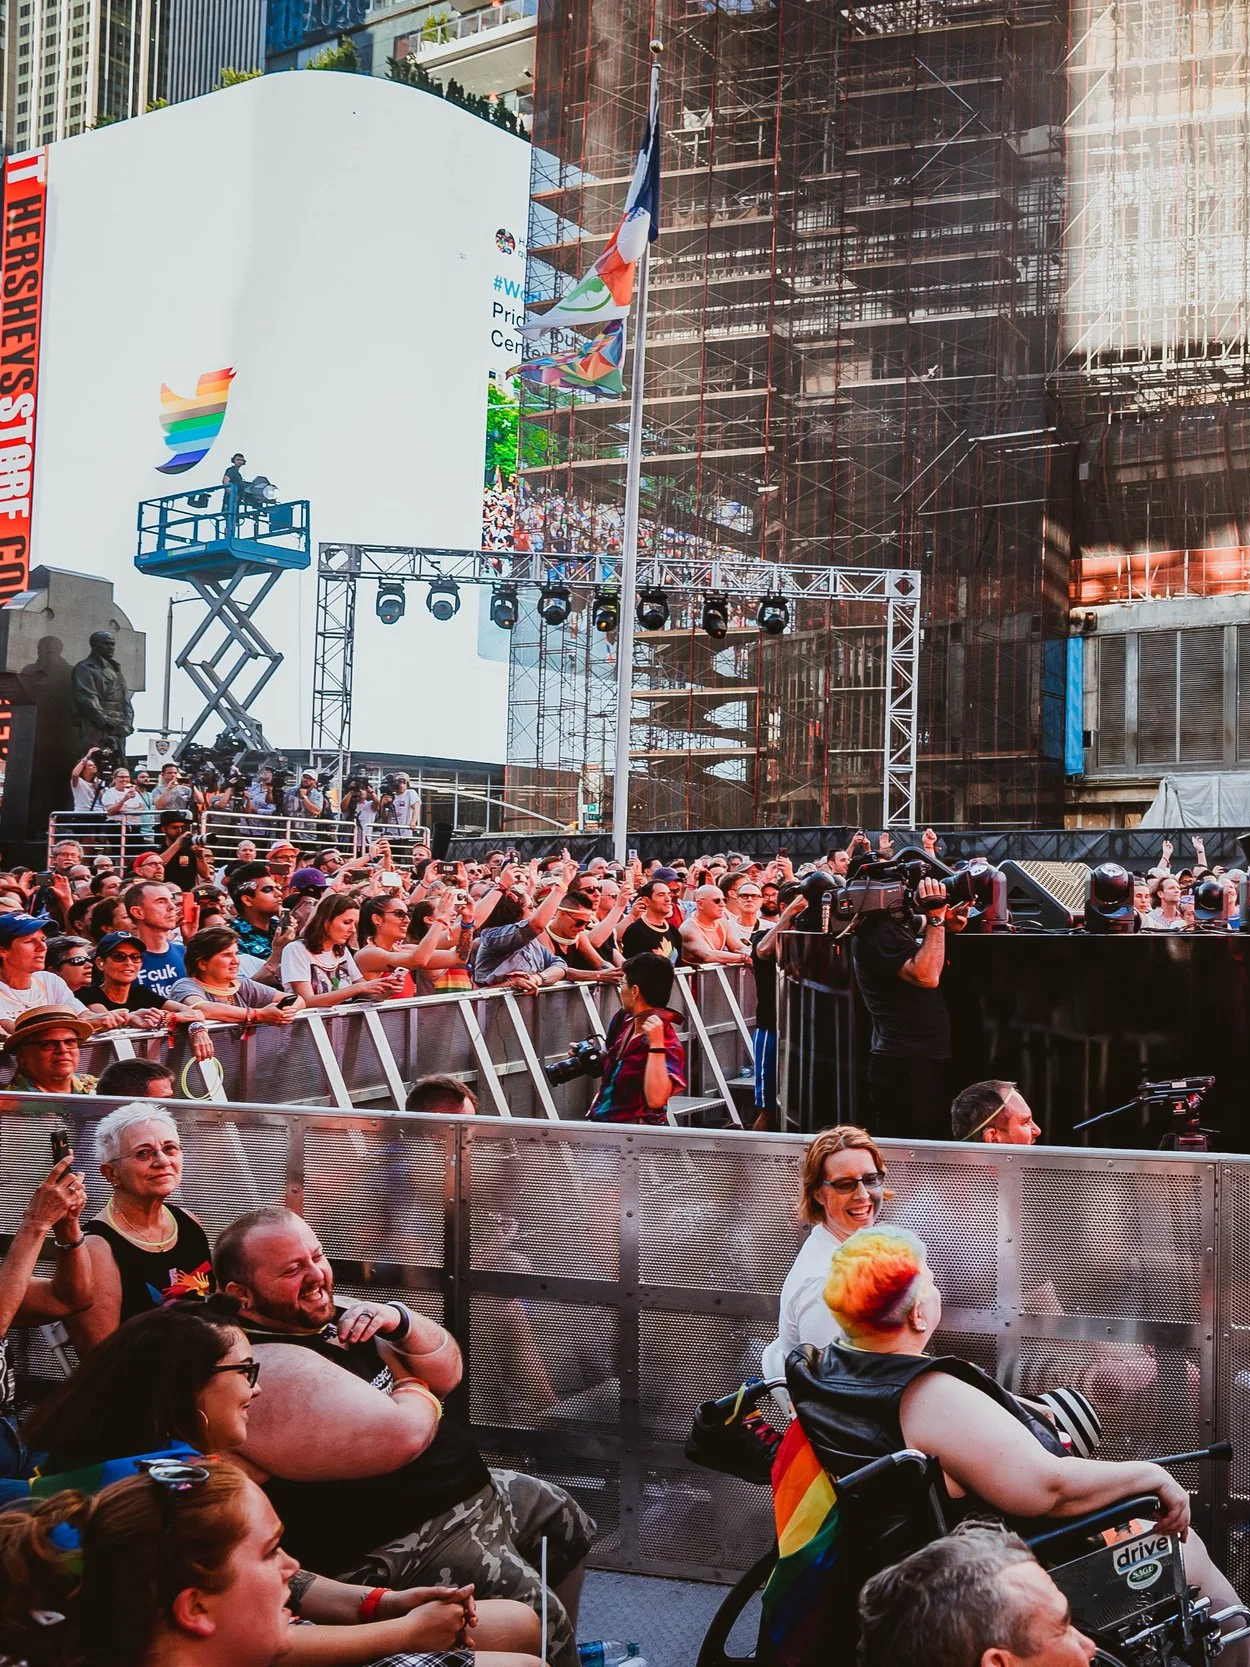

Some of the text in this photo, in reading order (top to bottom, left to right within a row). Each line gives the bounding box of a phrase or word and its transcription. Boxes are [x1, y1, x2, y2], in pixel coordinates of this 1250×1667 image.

[492, 301, 531, 328] Prid
[136, 964, 178, 985] Fcuk
[1116, 1536, 1169, 1568] drive
